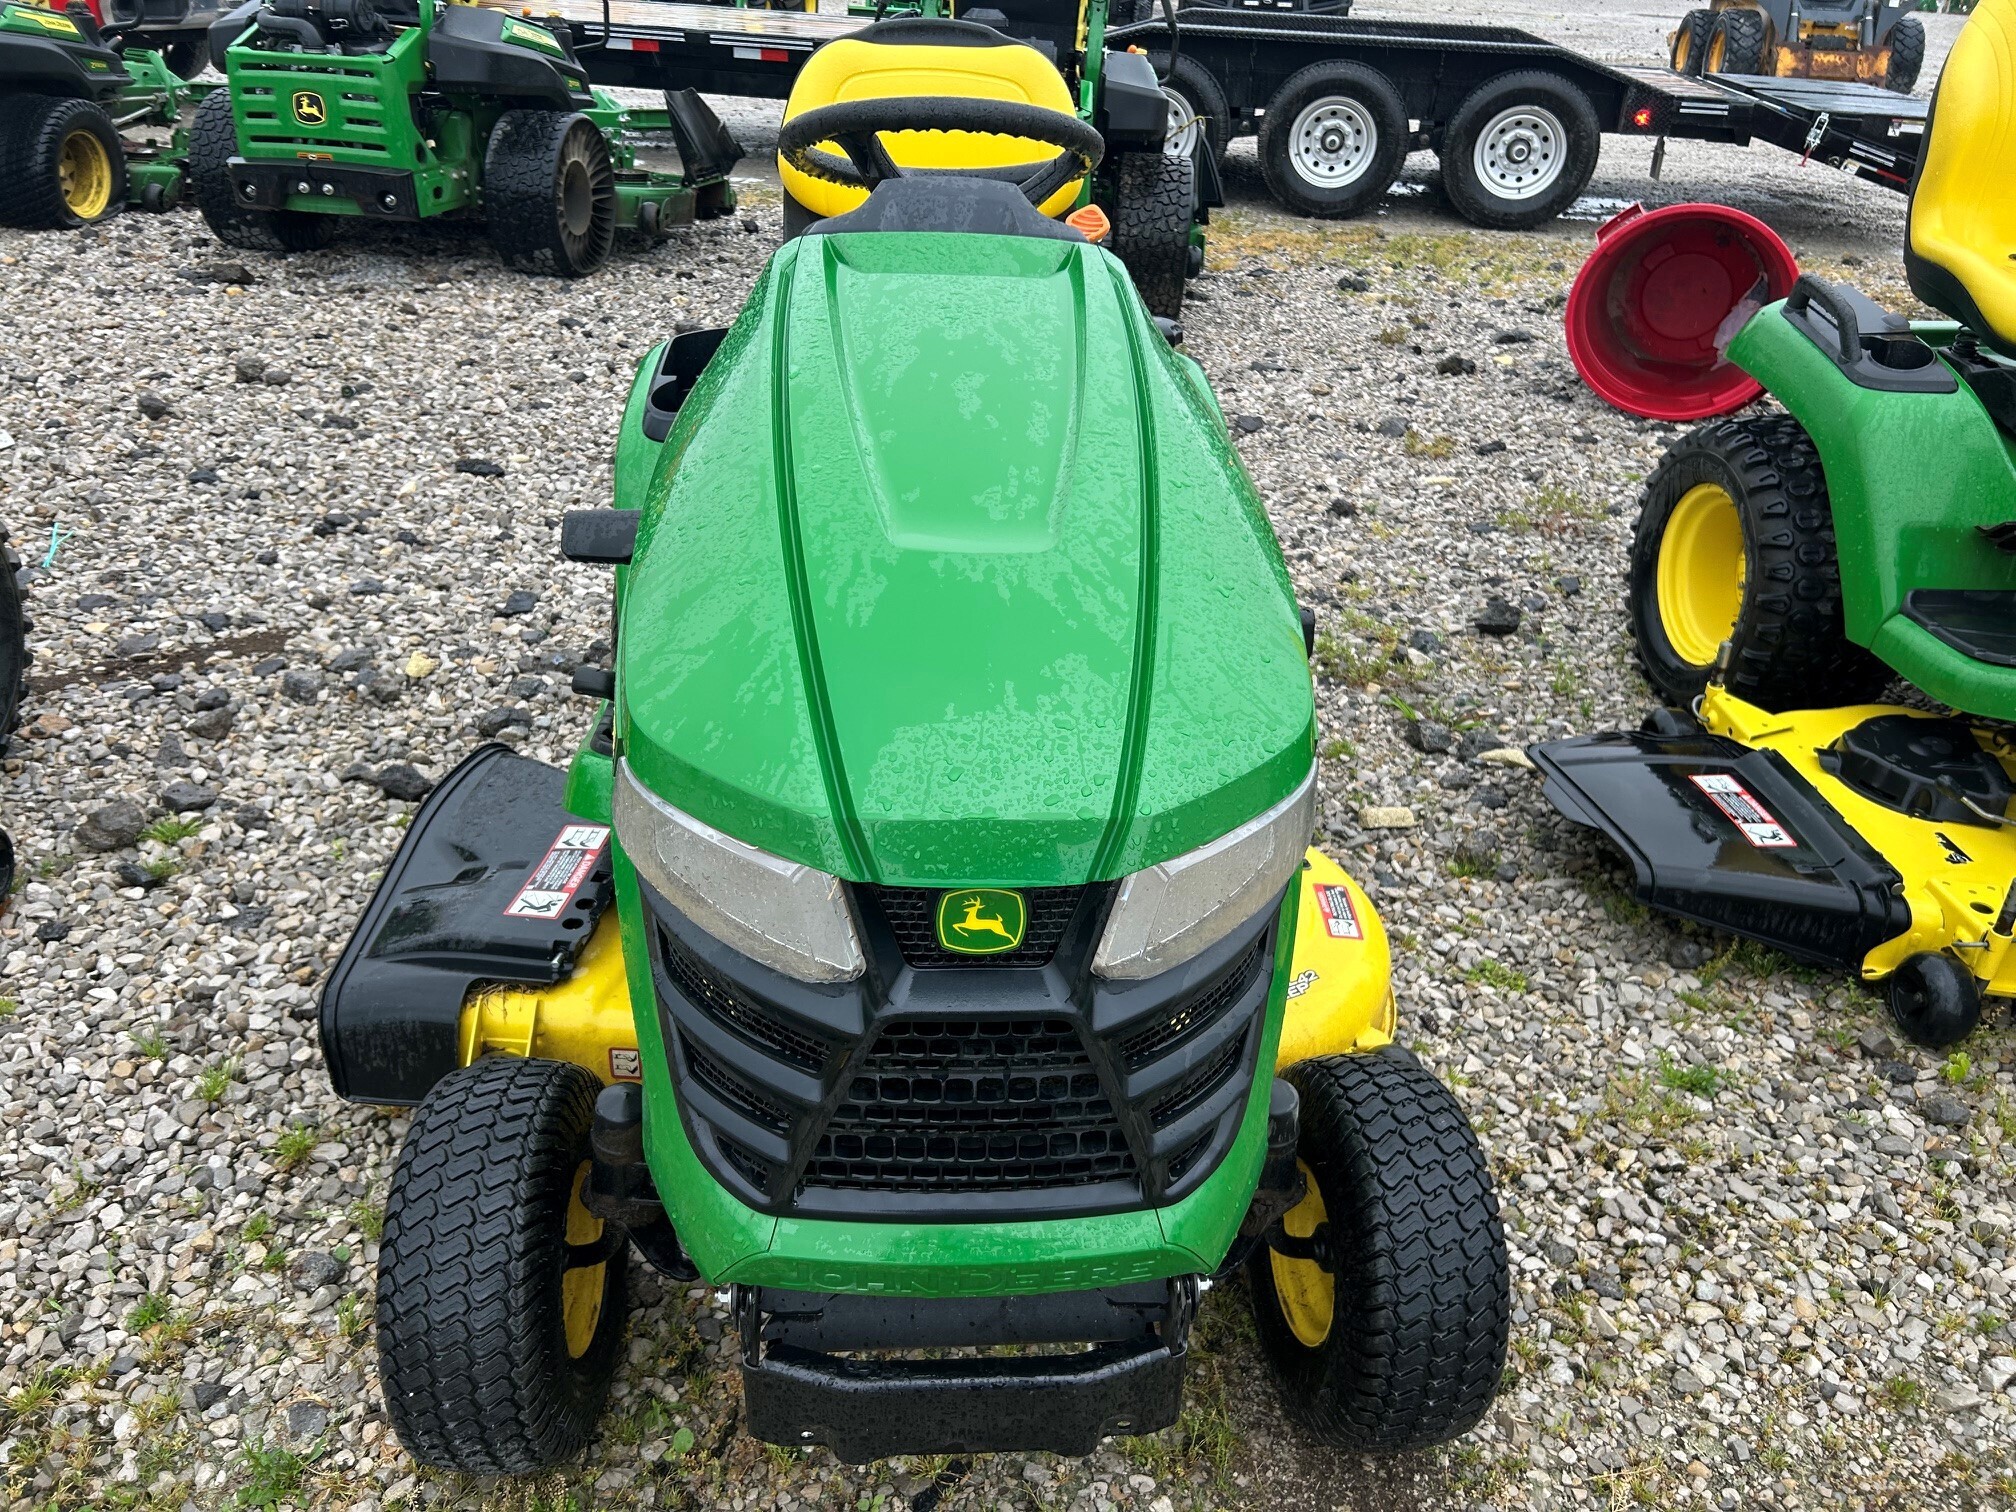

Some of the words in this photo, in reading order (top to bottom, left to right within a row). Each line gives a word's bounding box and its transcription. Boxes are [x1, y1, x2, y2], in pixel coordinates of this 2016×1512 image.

[570, 861, 591, 888] DANGER
[1297, 969, 1319, 984] 42
[1287, 981, 1310, 1000] EP
[771, 1263, 939, 1293] JOHN
[959, 1260, 1156, 1293] DEERE
